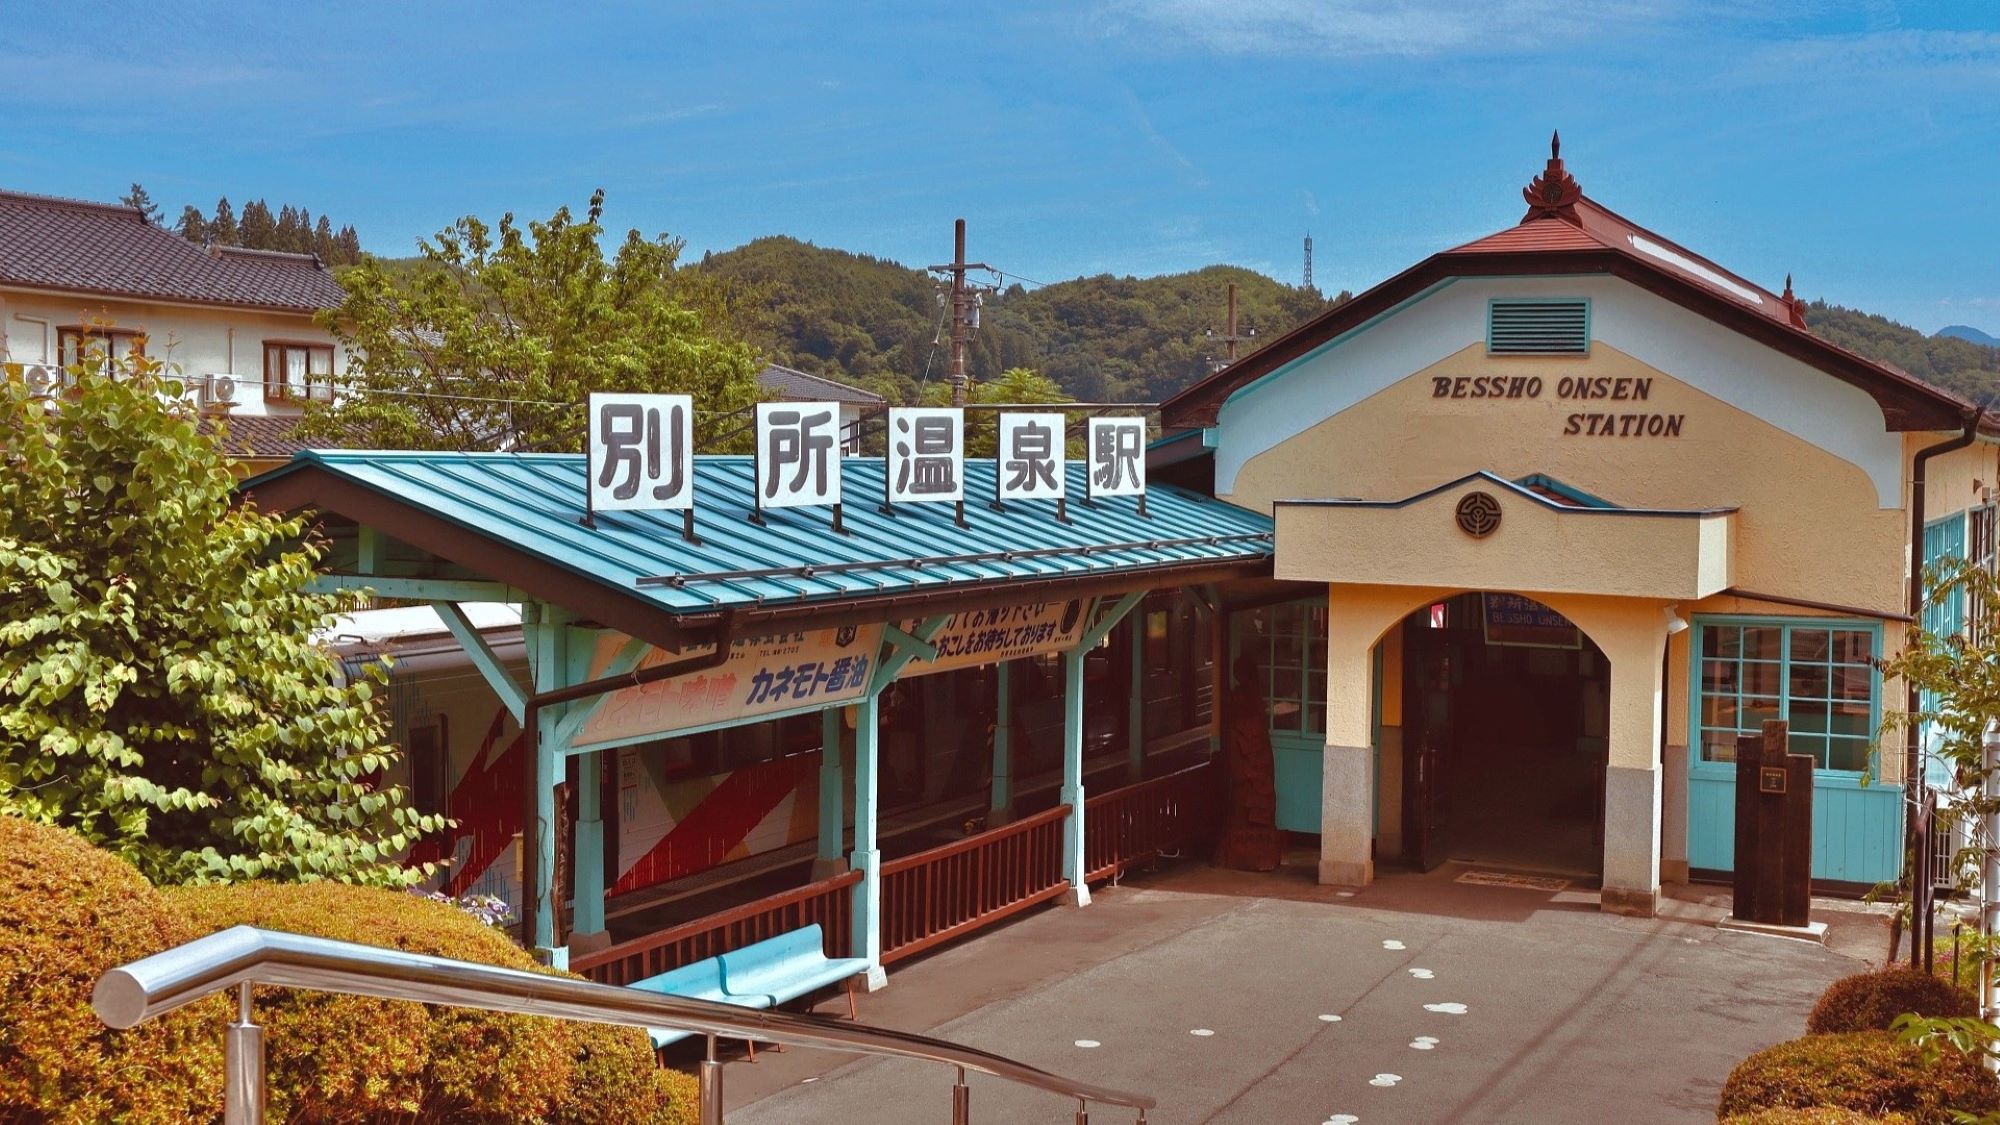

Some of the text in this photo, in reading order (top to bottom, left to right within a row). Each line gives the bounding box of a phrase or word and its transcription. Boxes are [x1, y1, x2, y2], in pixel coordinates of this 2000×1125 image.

[1432, 376, 1653, 400] BESSHO ONSEN
[1563, 413, 1685, 437] STATION
